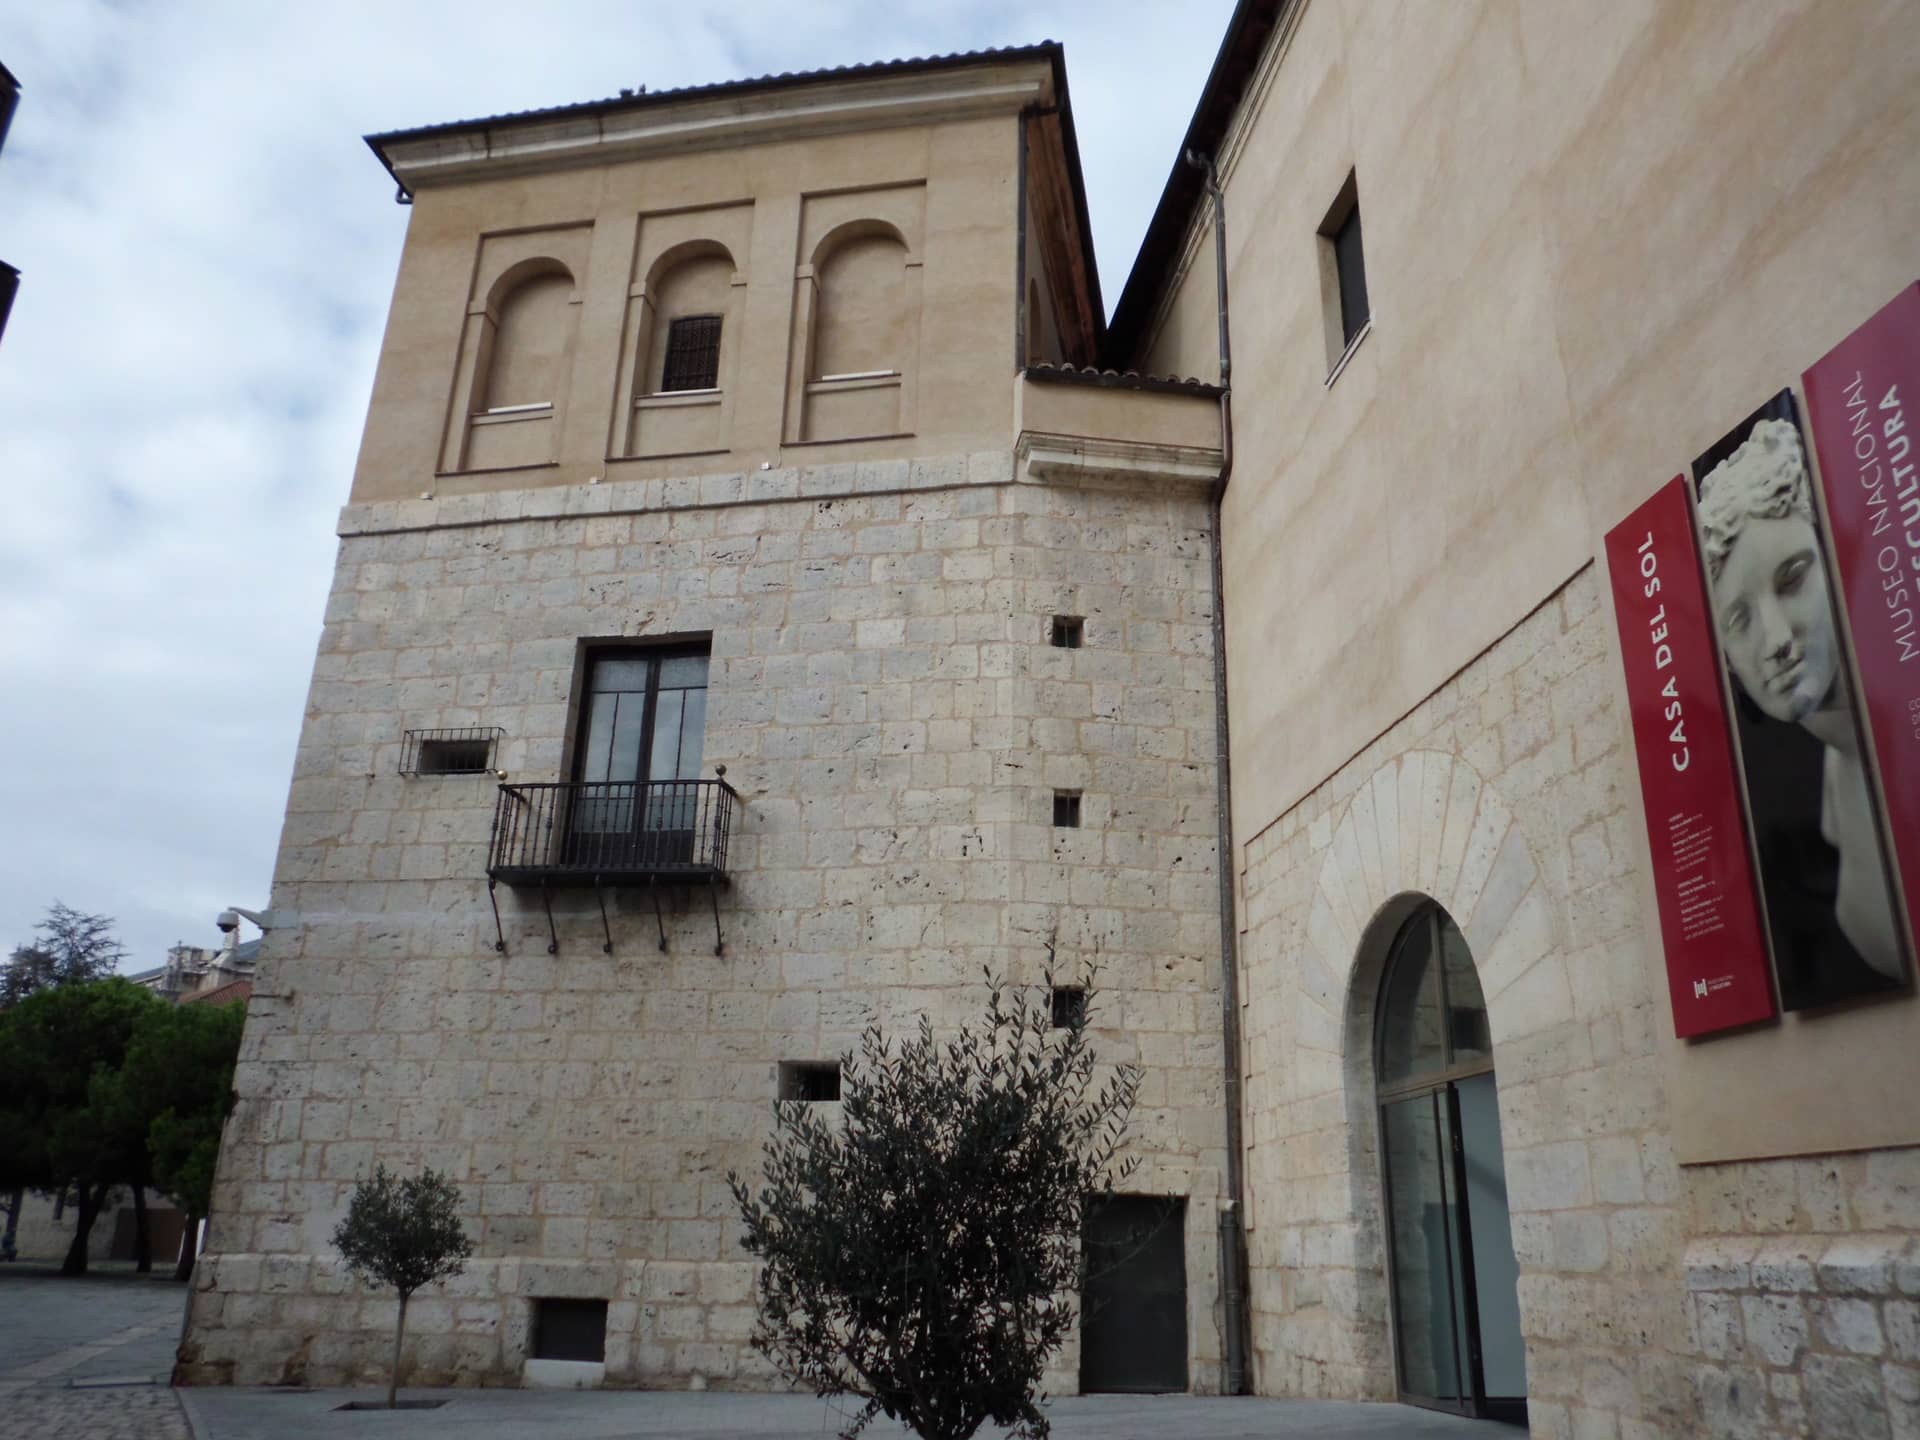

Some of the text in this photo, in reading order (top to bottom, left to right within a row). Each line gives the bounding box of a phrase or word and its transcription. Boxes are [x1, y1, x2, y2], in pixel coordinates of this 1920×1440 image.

[1842, 370, 1920, 662] MUSEO NACIONAL
[1878, 384, 1920, 593] CULTURA
[1637, 531, 1690, 772] CASA DEL SOL
